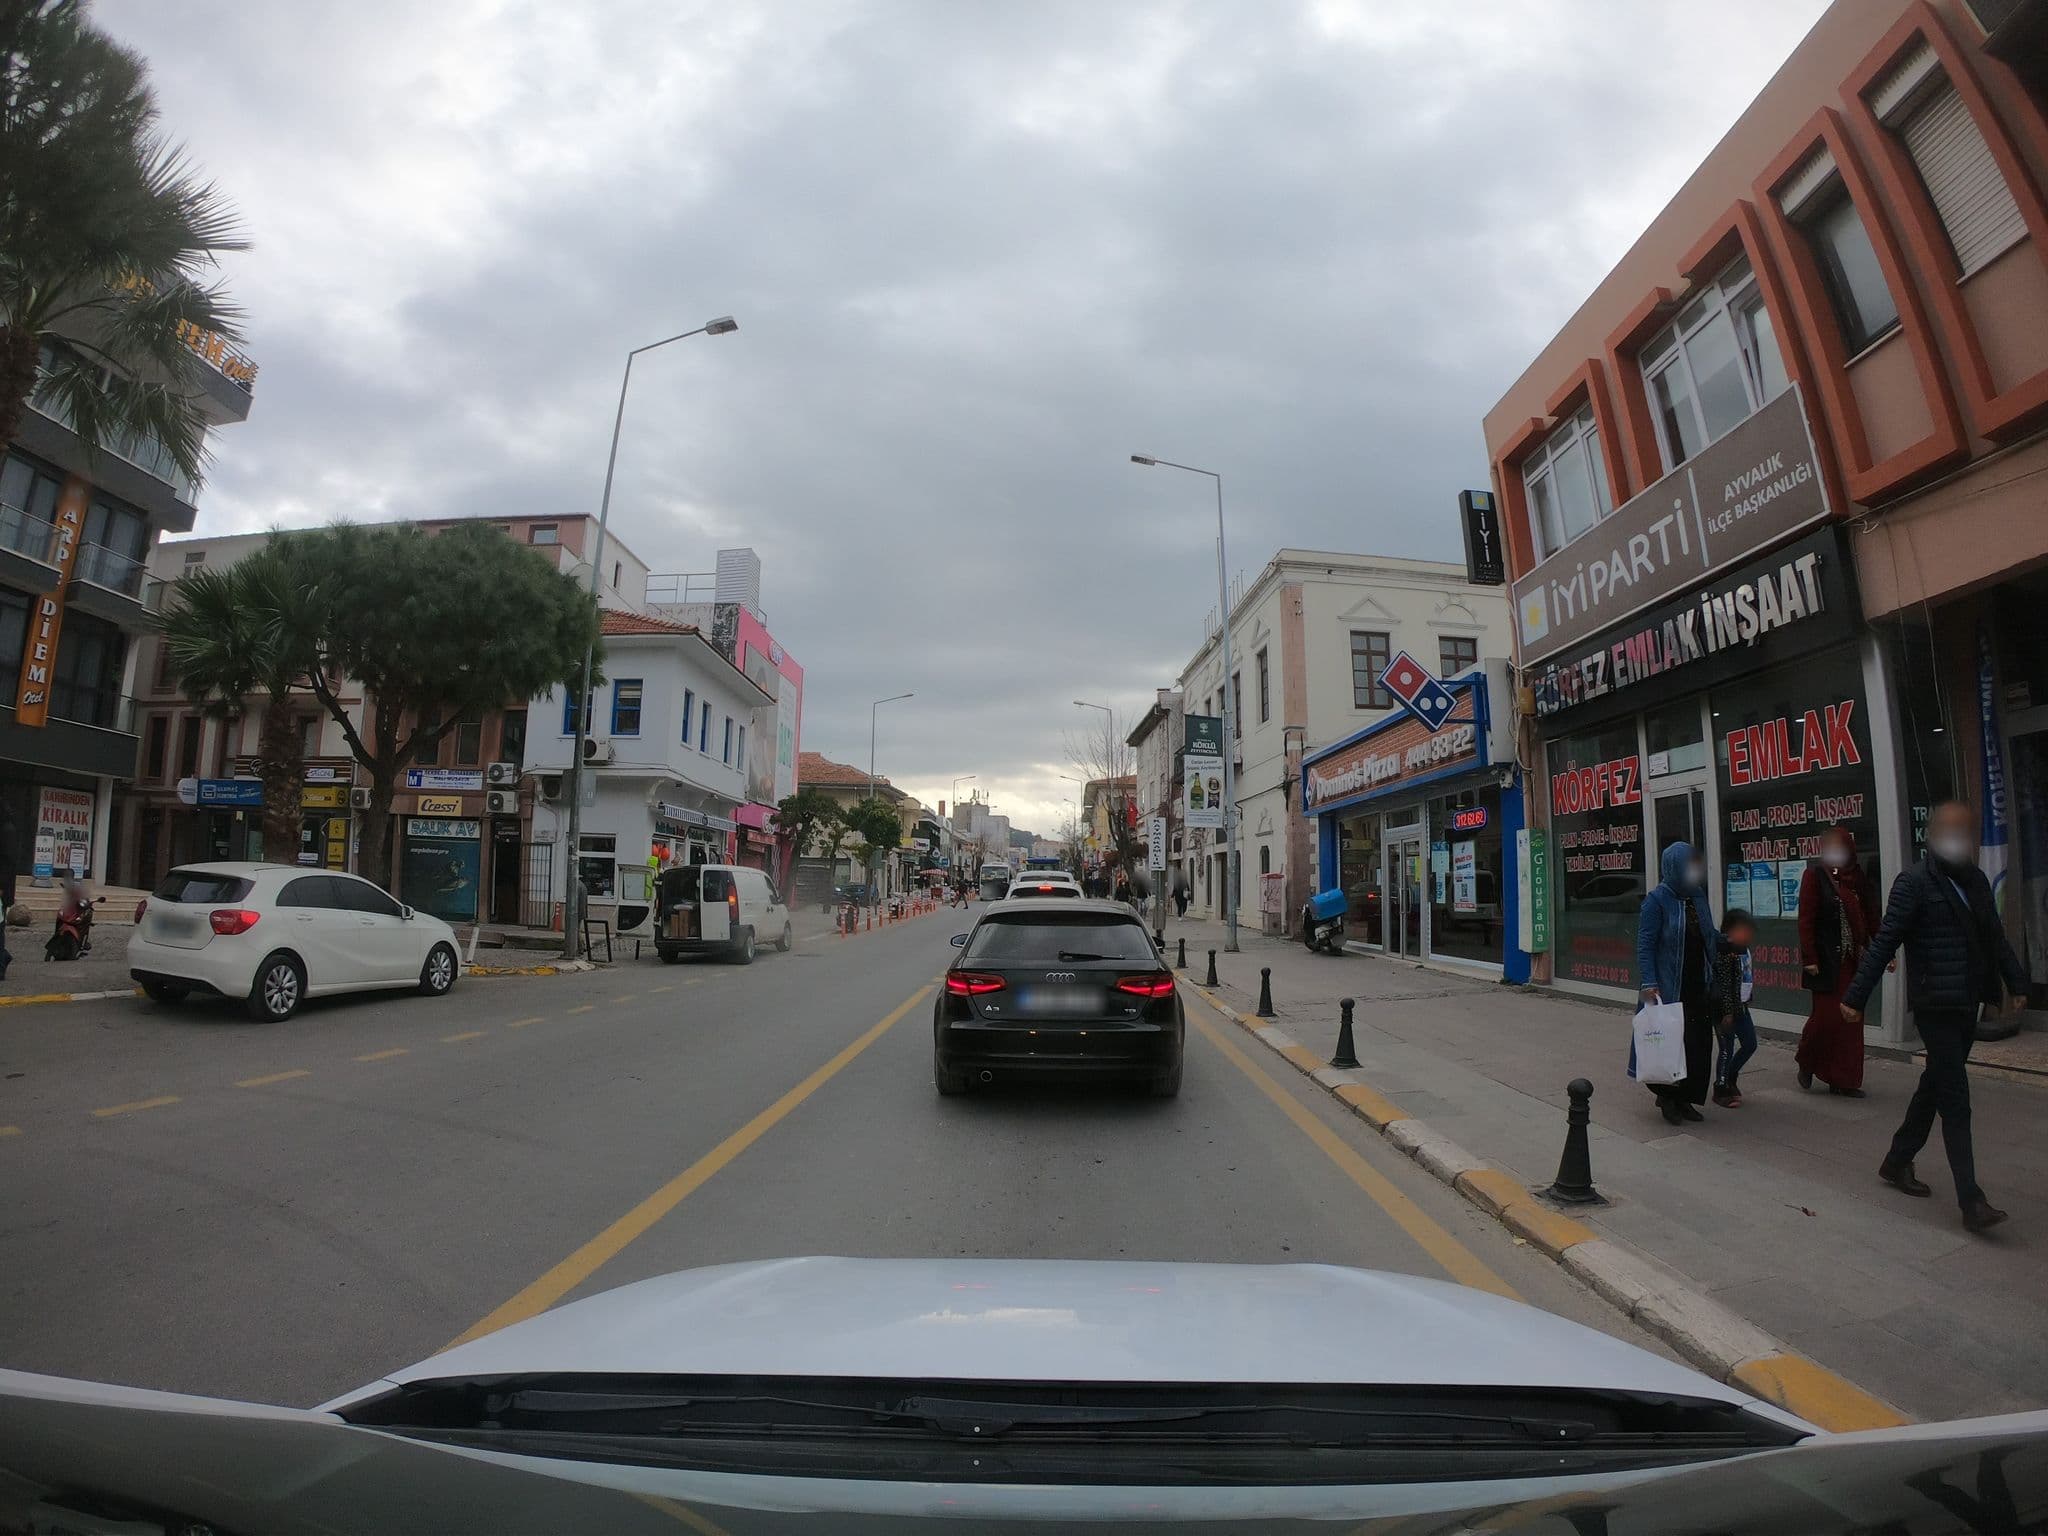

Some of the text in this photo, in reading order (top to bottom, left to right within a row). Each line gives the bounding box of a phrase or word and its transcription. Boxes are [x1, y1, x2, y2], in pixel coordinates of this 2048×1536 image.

[1707, 461, 1813, 536] İLÇE BAŞKANLIĞI
[1724, 451, 1784, 502] AYVALIK
[1535, 552, 1824, 718] KÖRFEZ EMLAK İNŞAAT
[1726, 699, 1861, 787] EMLAK
[1316, 761, 1363, 800] Domino's
[1363, 753, 1401, 784] Pizza
[1552, 755, 1641, 816] KÖRFEZ
[42, 804, 89, 826] KİRALIK
[421, 797, 459, 813] Cressi
[1730, 808, 1761, 832] PLAN
[1767, 802, 1807, 828] PROJE
[1814, 793, 1863, 826] İNŞAAT
[1741, 836, 1789, 863] TADİLAT
[1534, 852, 1545, 943] Groupama
